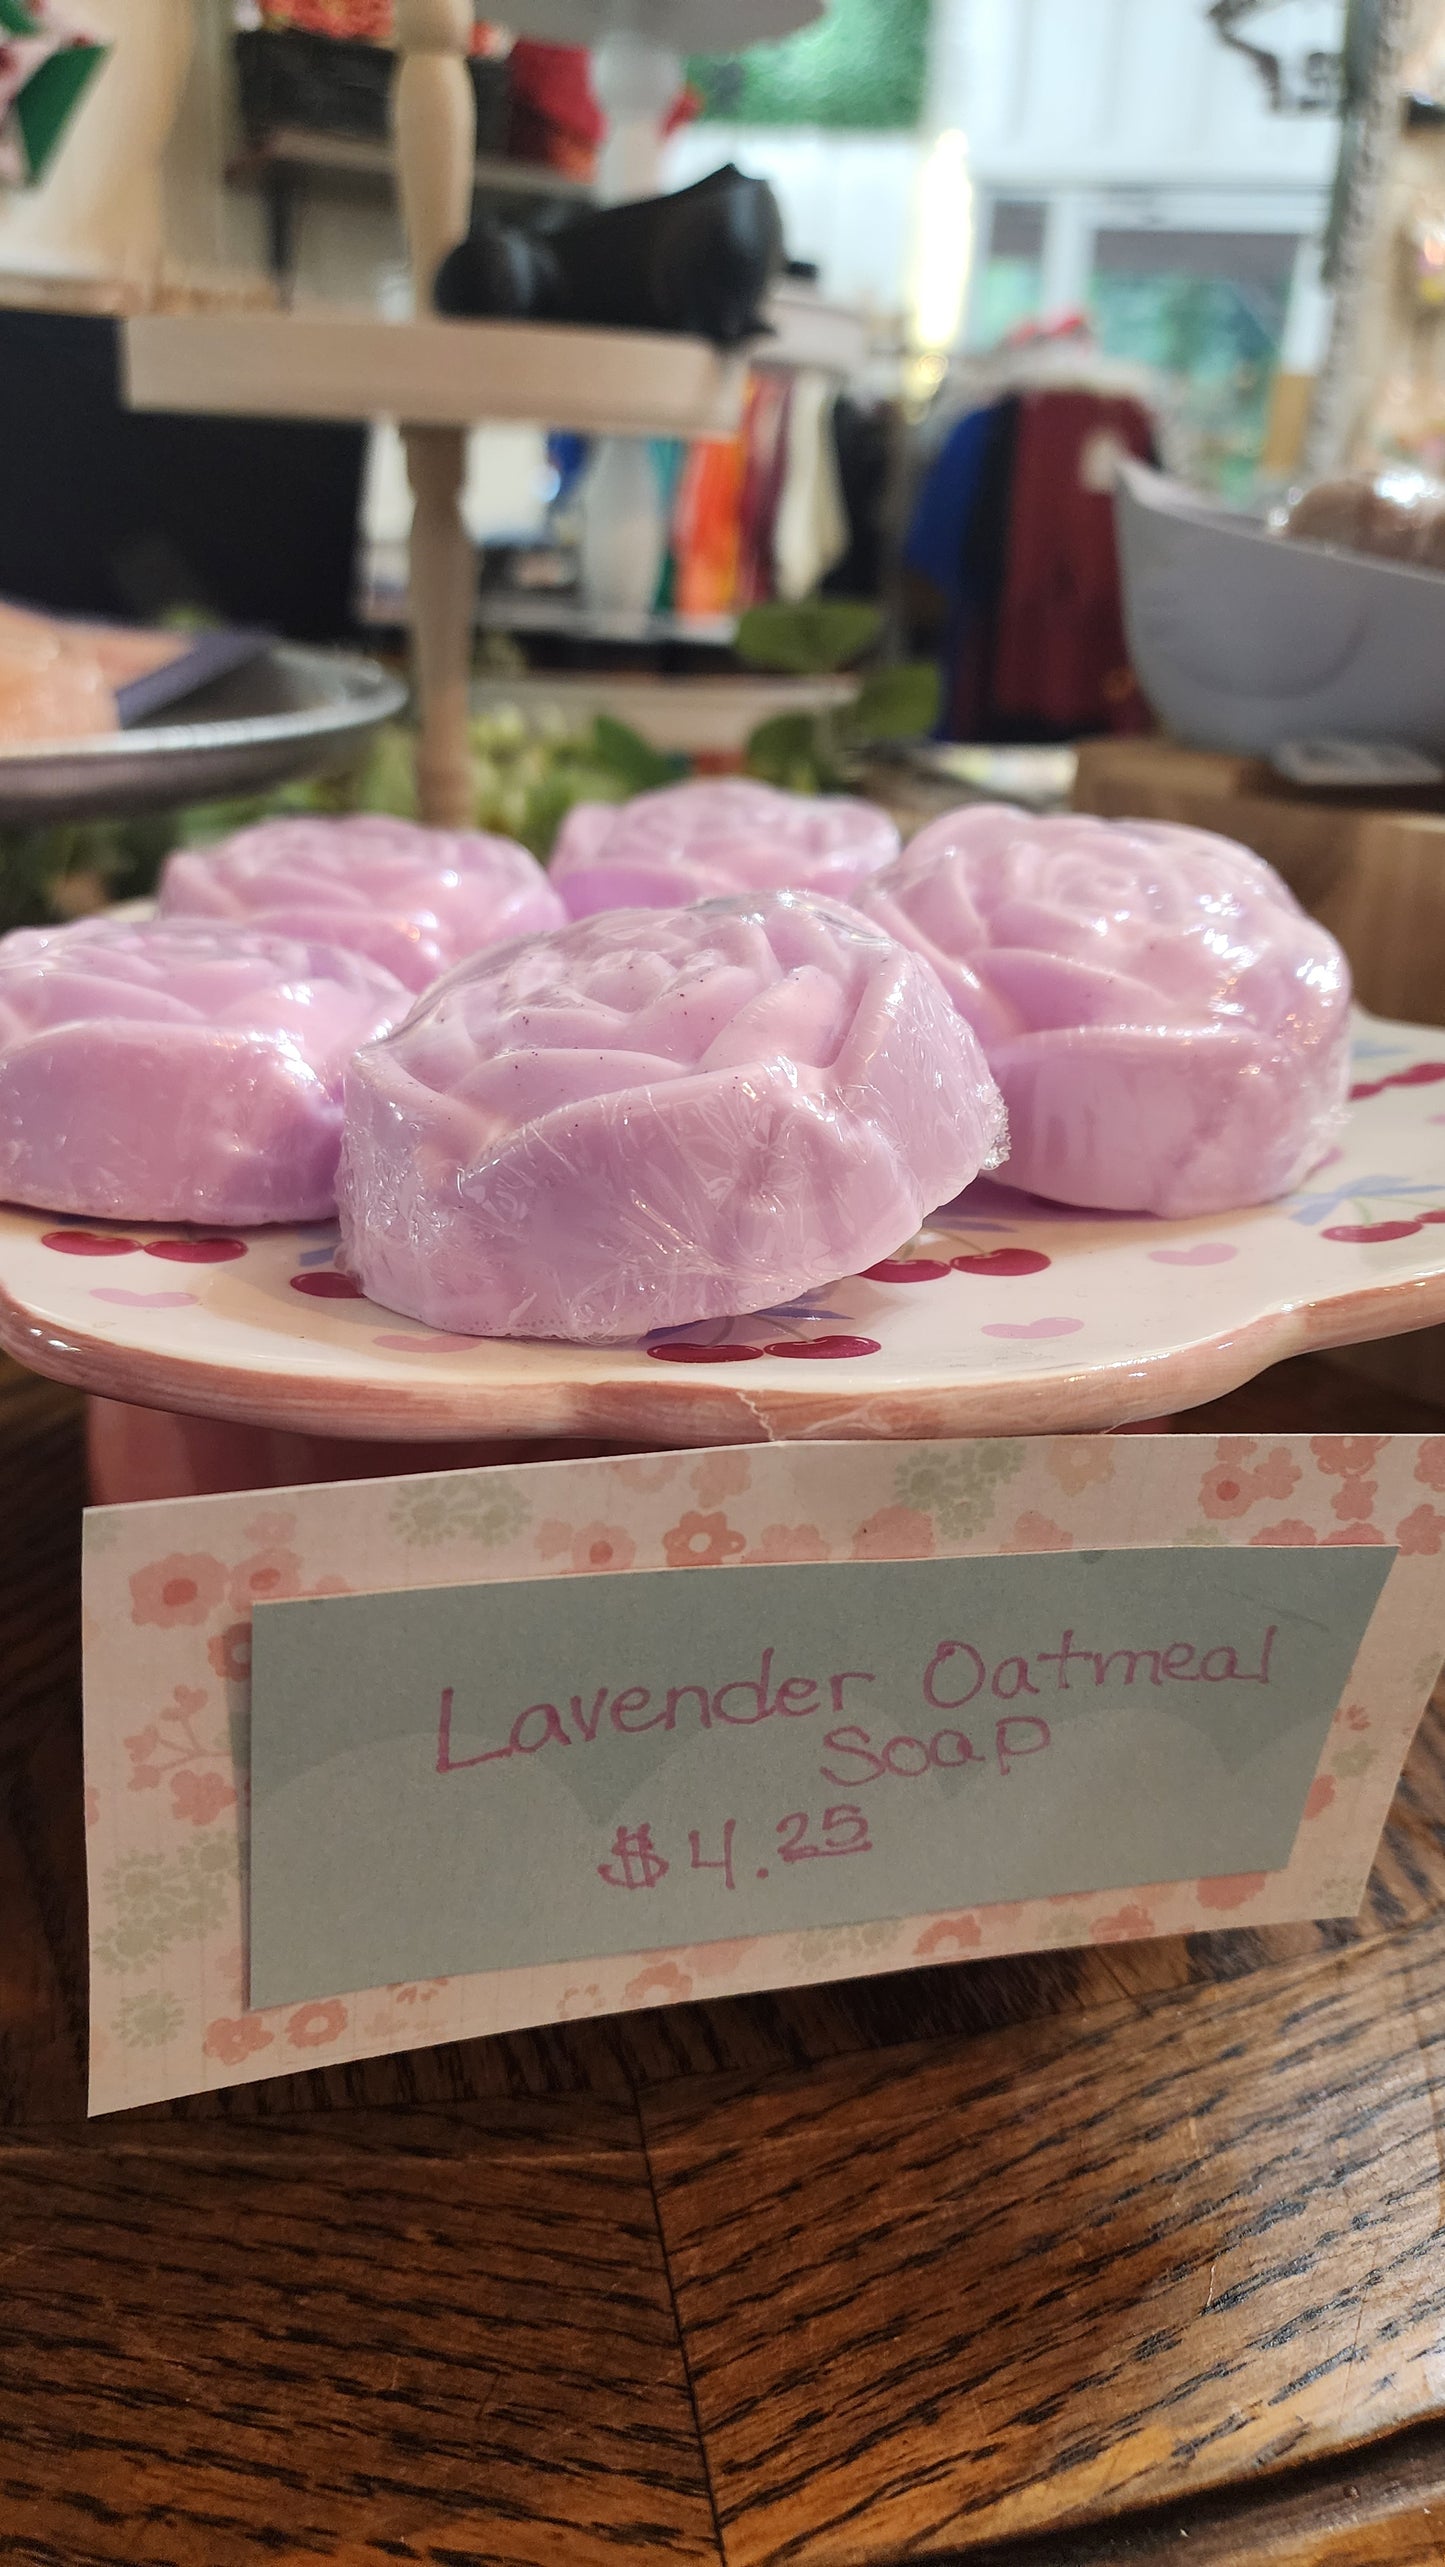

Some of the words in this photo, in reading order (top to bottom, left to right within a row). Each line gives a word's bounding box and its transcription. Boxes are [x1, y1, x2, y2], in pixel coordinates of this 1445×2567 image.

[435, 1646, 877, 1774] Lavender
[922, 1625, 1280, 1710] Oatmeal
[598, 1803, 874, 1892] $4.25
